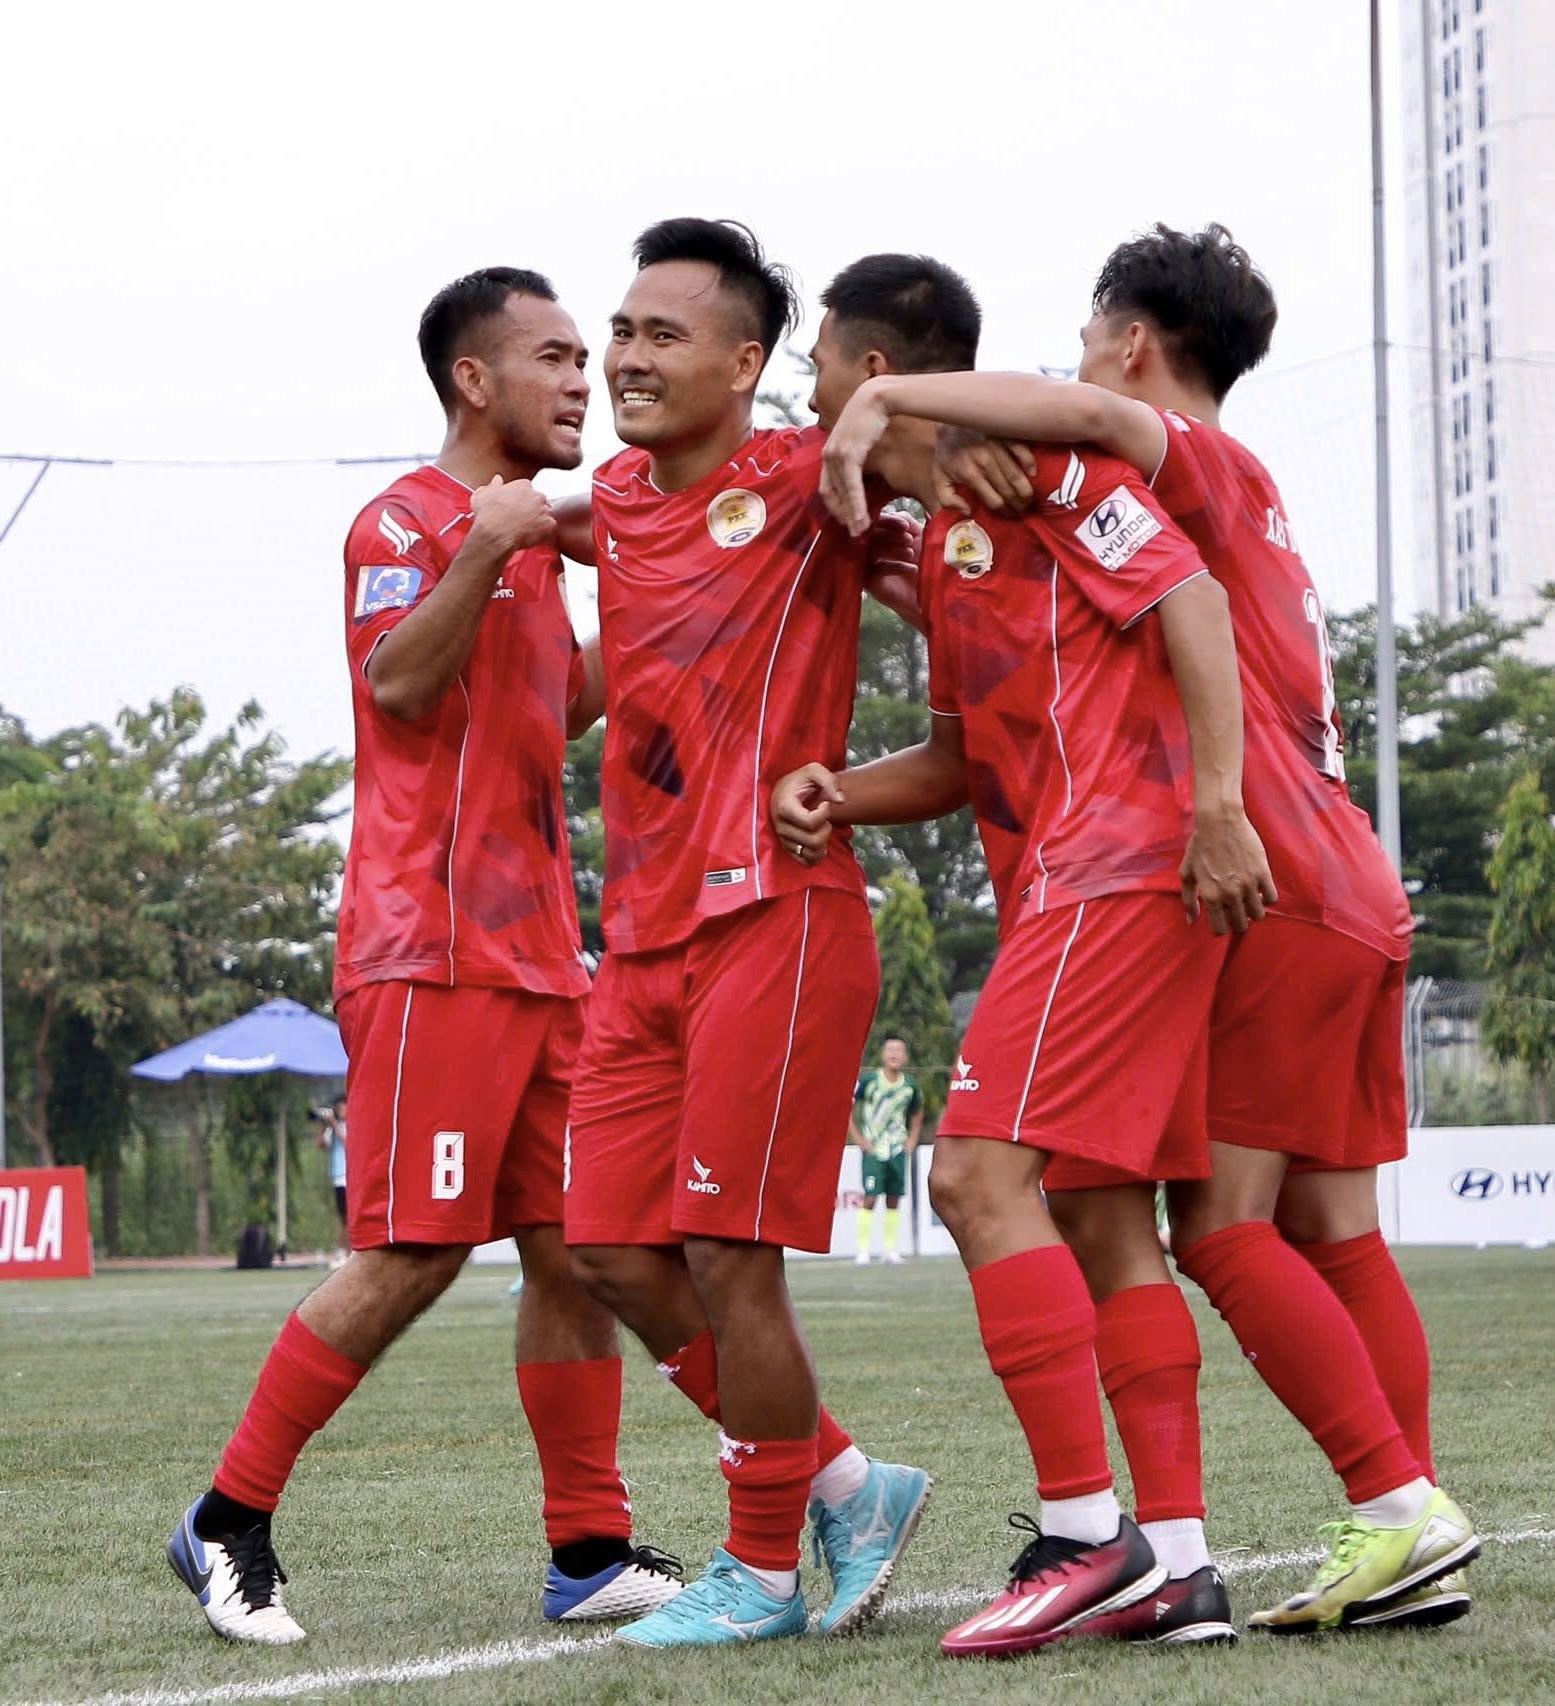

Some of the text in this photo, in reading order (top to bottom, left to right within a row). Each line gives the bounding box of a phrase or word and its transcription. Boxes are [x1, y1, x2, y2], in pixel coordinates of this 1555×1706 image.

[1099, 510, 1152, 563] HYUNDAI
[1122, 524, 1160, 559] MOTOR
[431, 1131, 465, 1200] 8
[687, 1178, 721, 1195] KAMITO
